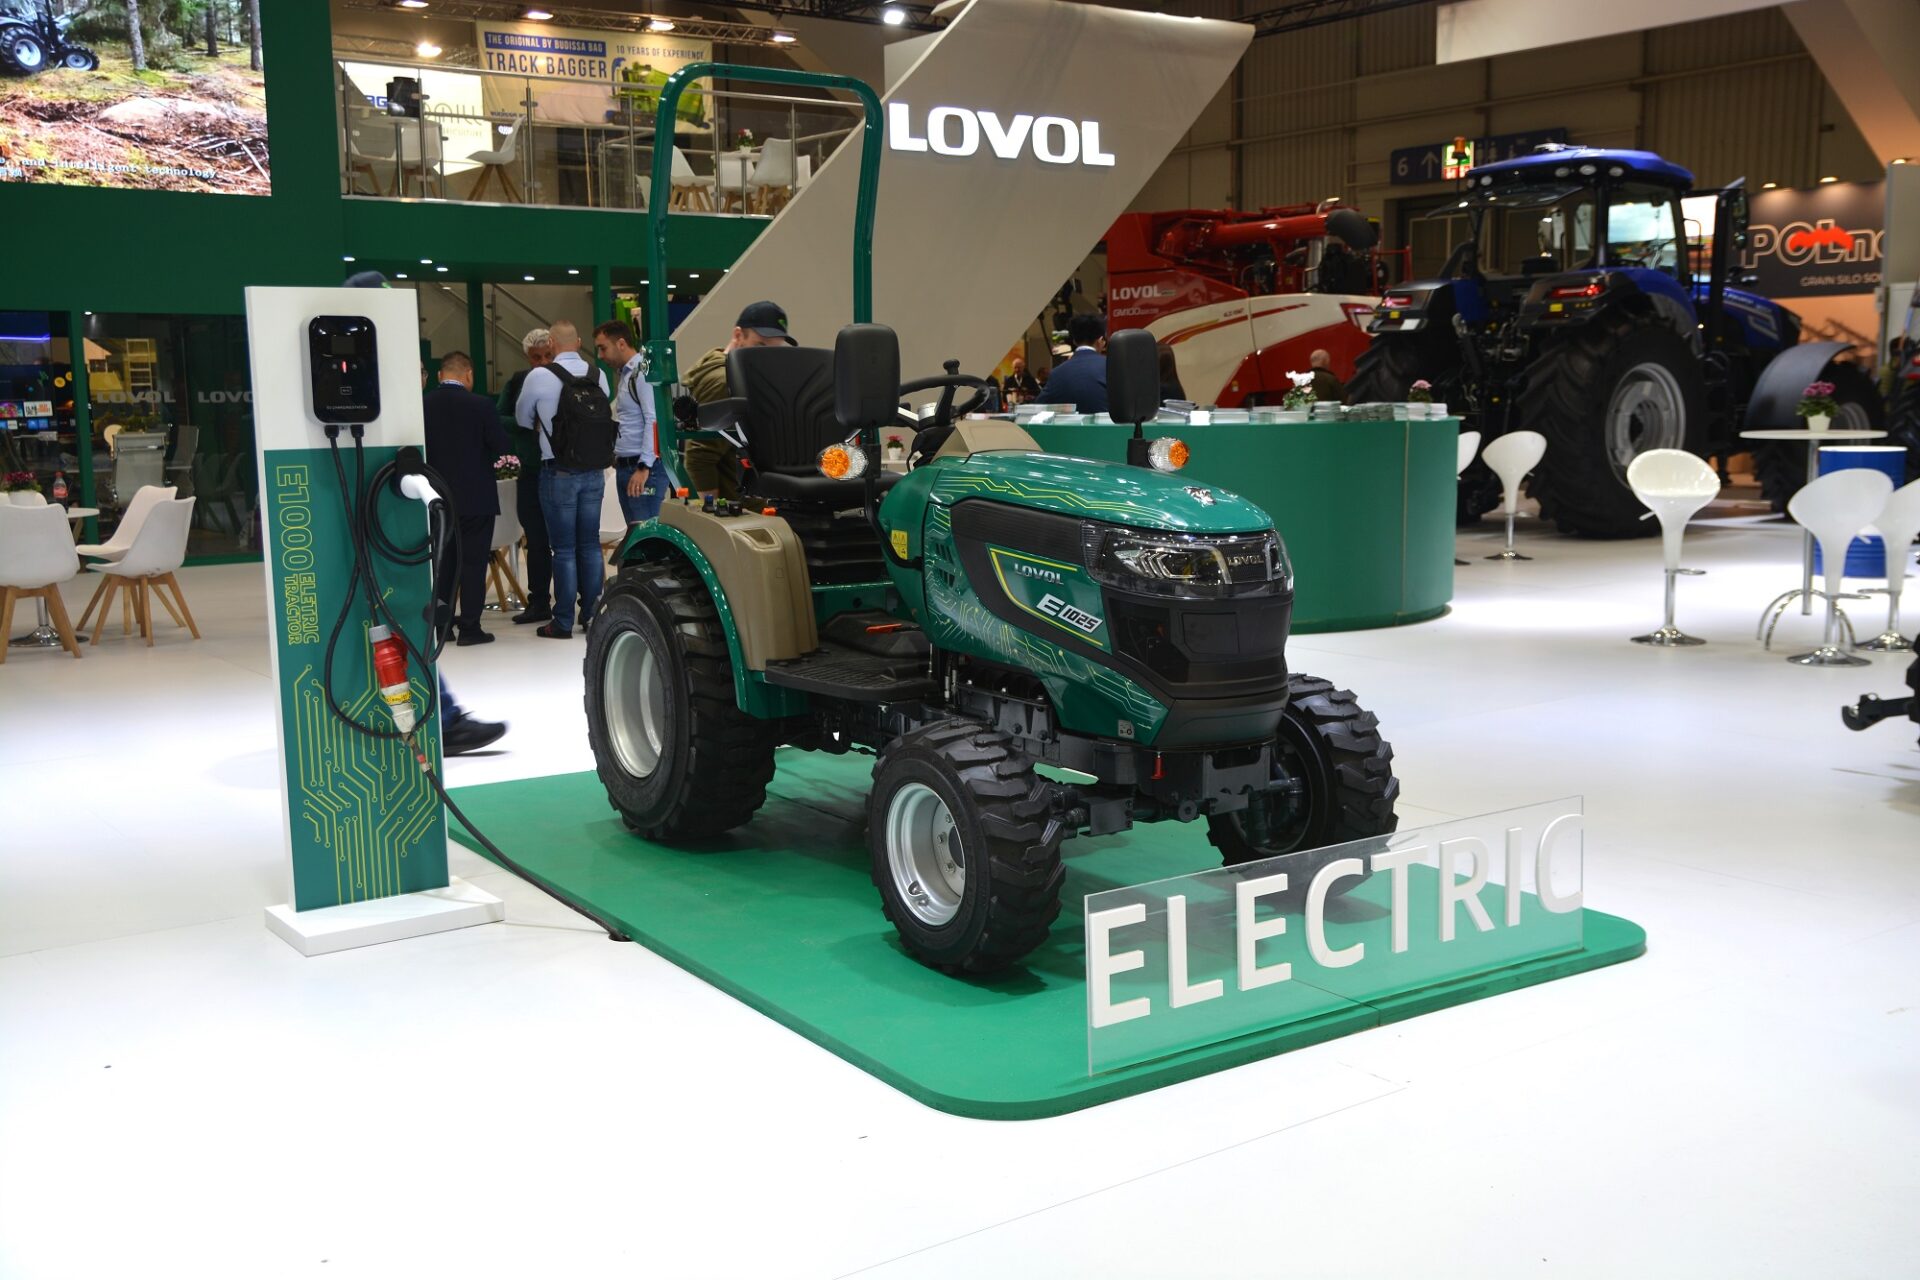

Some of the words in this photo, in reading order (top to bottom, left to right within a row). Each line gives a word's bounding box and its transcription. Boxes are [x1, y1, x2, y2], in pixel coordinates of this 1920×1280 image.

[487, 34, 503, 45] THE
[505, 35, 540, 48] ORIGINAL
[542, 38, 552, 48] BY
[616, 45, 625, 54] 10
[626, 46, 650, 57] YEARS
[652, 48, 660, 57] OF
[662, 49, 705, 60] EXPERIENCE
[486, 52, 540, 74] TRACK
[547, 56, 608, 79] BAGGER
[888, 102, 1116, 167] LOVOL
[146, 164, 216, 180] technology
[1397, 156, 1409, 177] 6
[1801, 275, 1835, 287] GRAIN
[1112, 284, 1161, 301] LOVOL
[97, 391, 176, 403] LOVOL
[276, 465, 314, 571] E1000
[1226, 555, 1265, 566] LOVOL
[1014, 563, 1064, 585] LOVOL
[284, 573, 303, 645] TRACTOR
[299, 572, 320, 644] ELETRIC
[1088, 813, 1584, 1029] ELECTRIC
